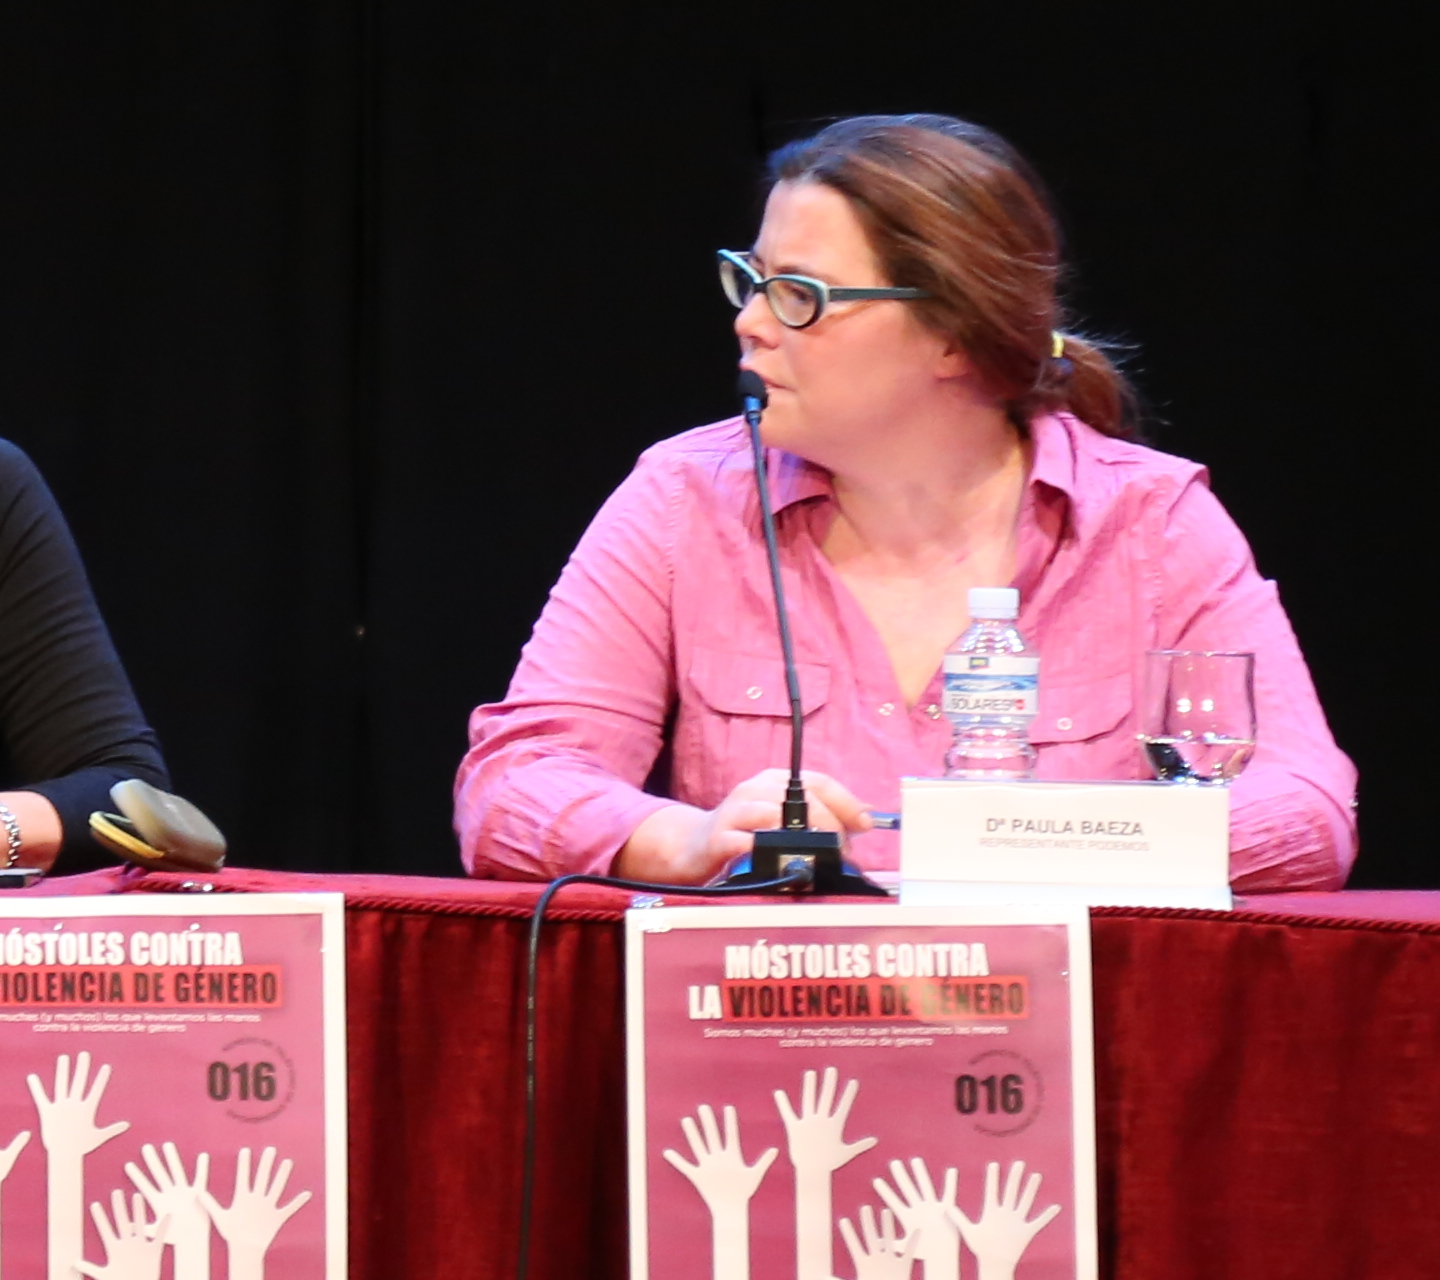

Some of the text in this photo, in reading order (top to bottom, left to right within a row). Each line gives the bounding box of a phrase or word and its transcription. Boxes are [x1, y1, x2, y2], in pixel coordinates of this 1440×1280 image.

[1012, 819, 1073, 834] PAULA
[1081, 821, 1144, 836] BAEZA
[130, 932, 244, 967] CONTRA
[725, 939, 990, 979] MÓSTOLES CONTRA
[133, 971, 165, 1003] DE
[174, 966, 278, 1004] GÉNERO
[688, 985, 722, 1020] LA
[728, 984, 870, 1018] VIOLENCIA
[880, 984, 912, 1017] DE
[207, 1061, 277, 1101] 016
[955, 1074, 1024, 1115] 016
